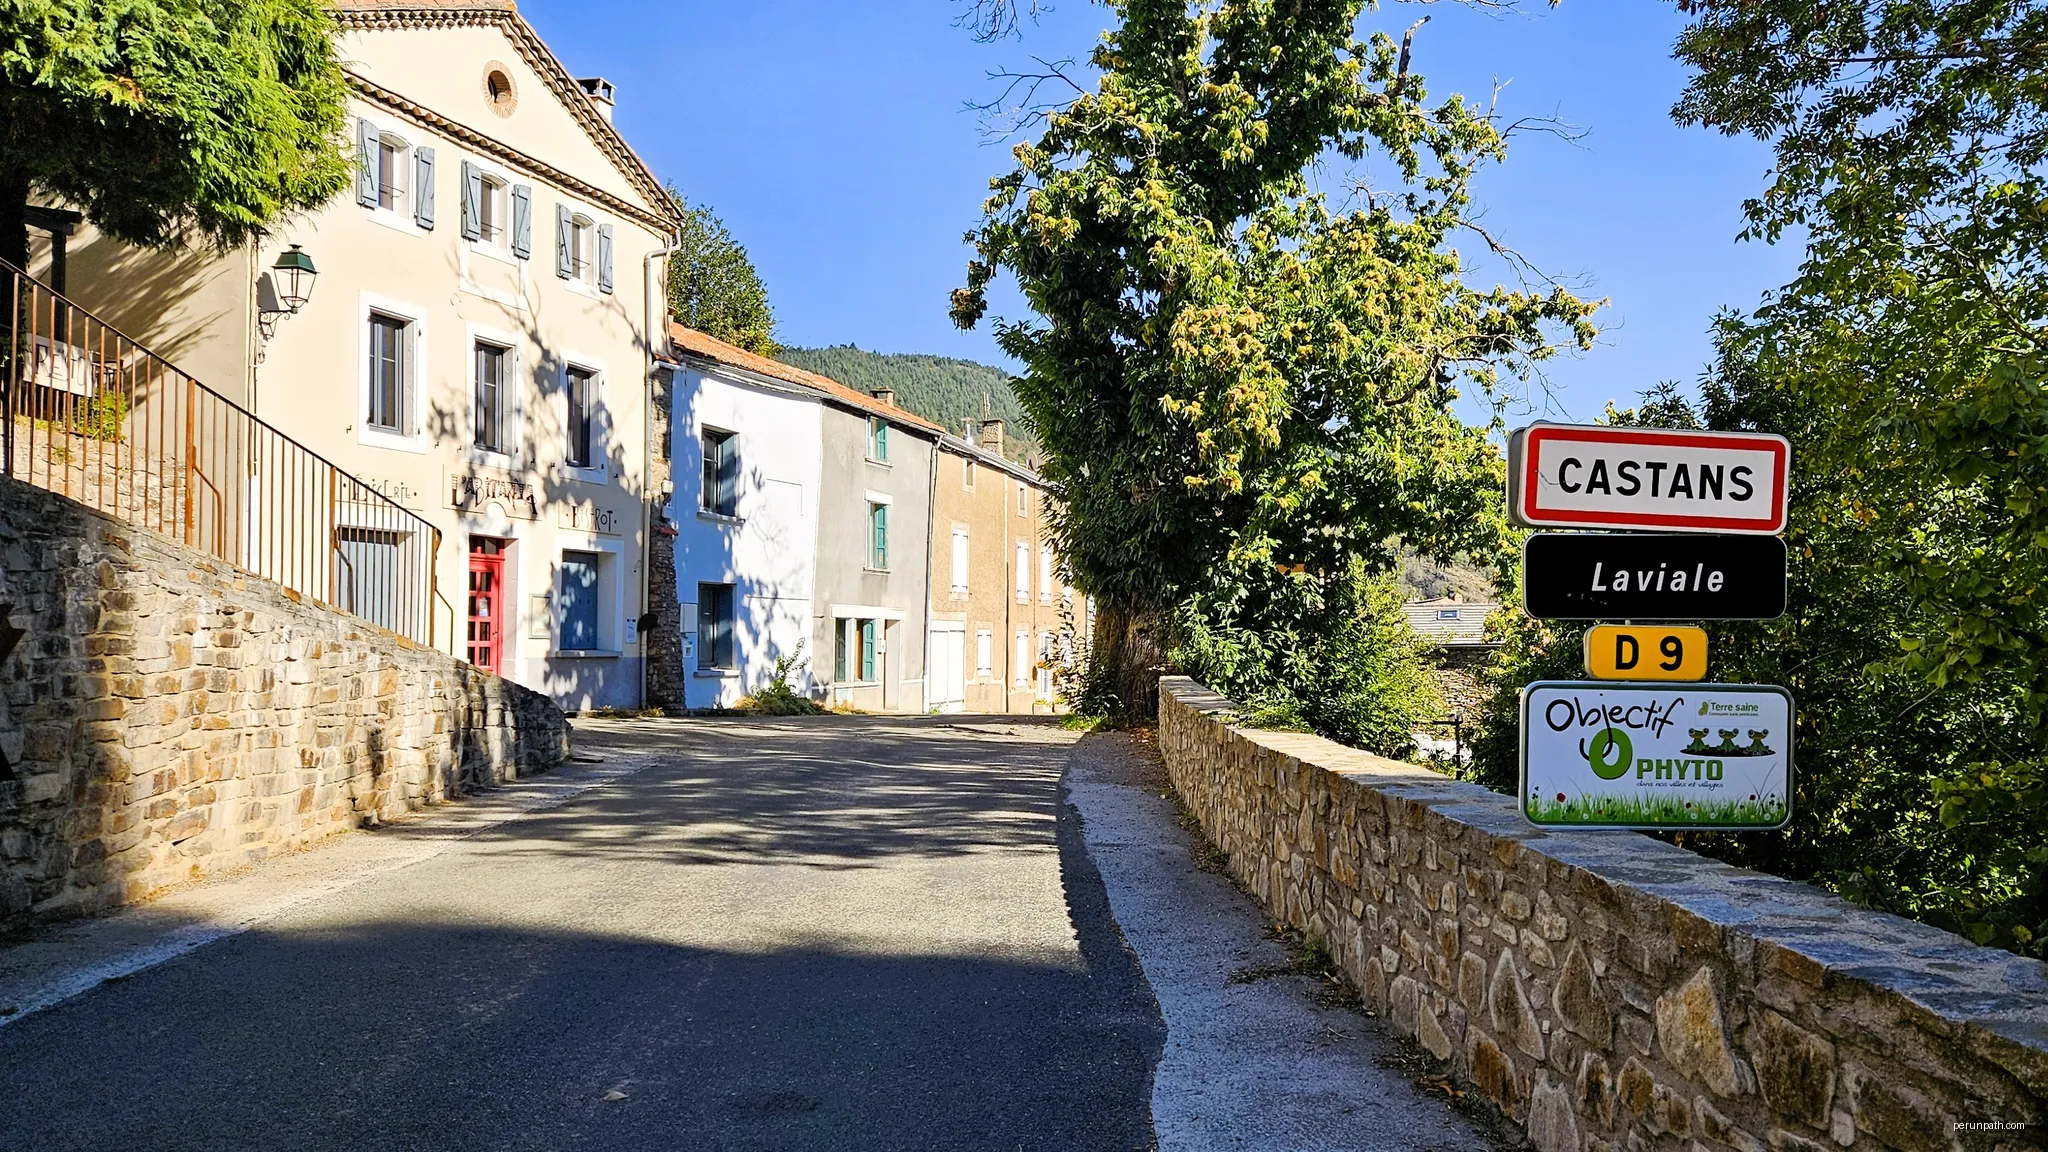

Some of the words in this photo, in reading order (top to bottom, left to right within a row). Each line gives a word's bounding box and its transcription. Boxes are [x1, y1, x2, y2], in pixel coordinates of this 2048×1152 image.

[1558, 457, 1754, 501] CASTANS
[1591, 562, 1724, 592] Laviale
[1615, 634, 1639, 670] D
[1659, 635, 1683, 671] 9
[1710, 702, 1733, 711] Terre
[1735, 702, 1759, 712] saine
[1545, 692, 1685, 760] Objectif
[1636, 758, 1723, 780] PHYTO
[1697, 780, 1724, 791] villages
